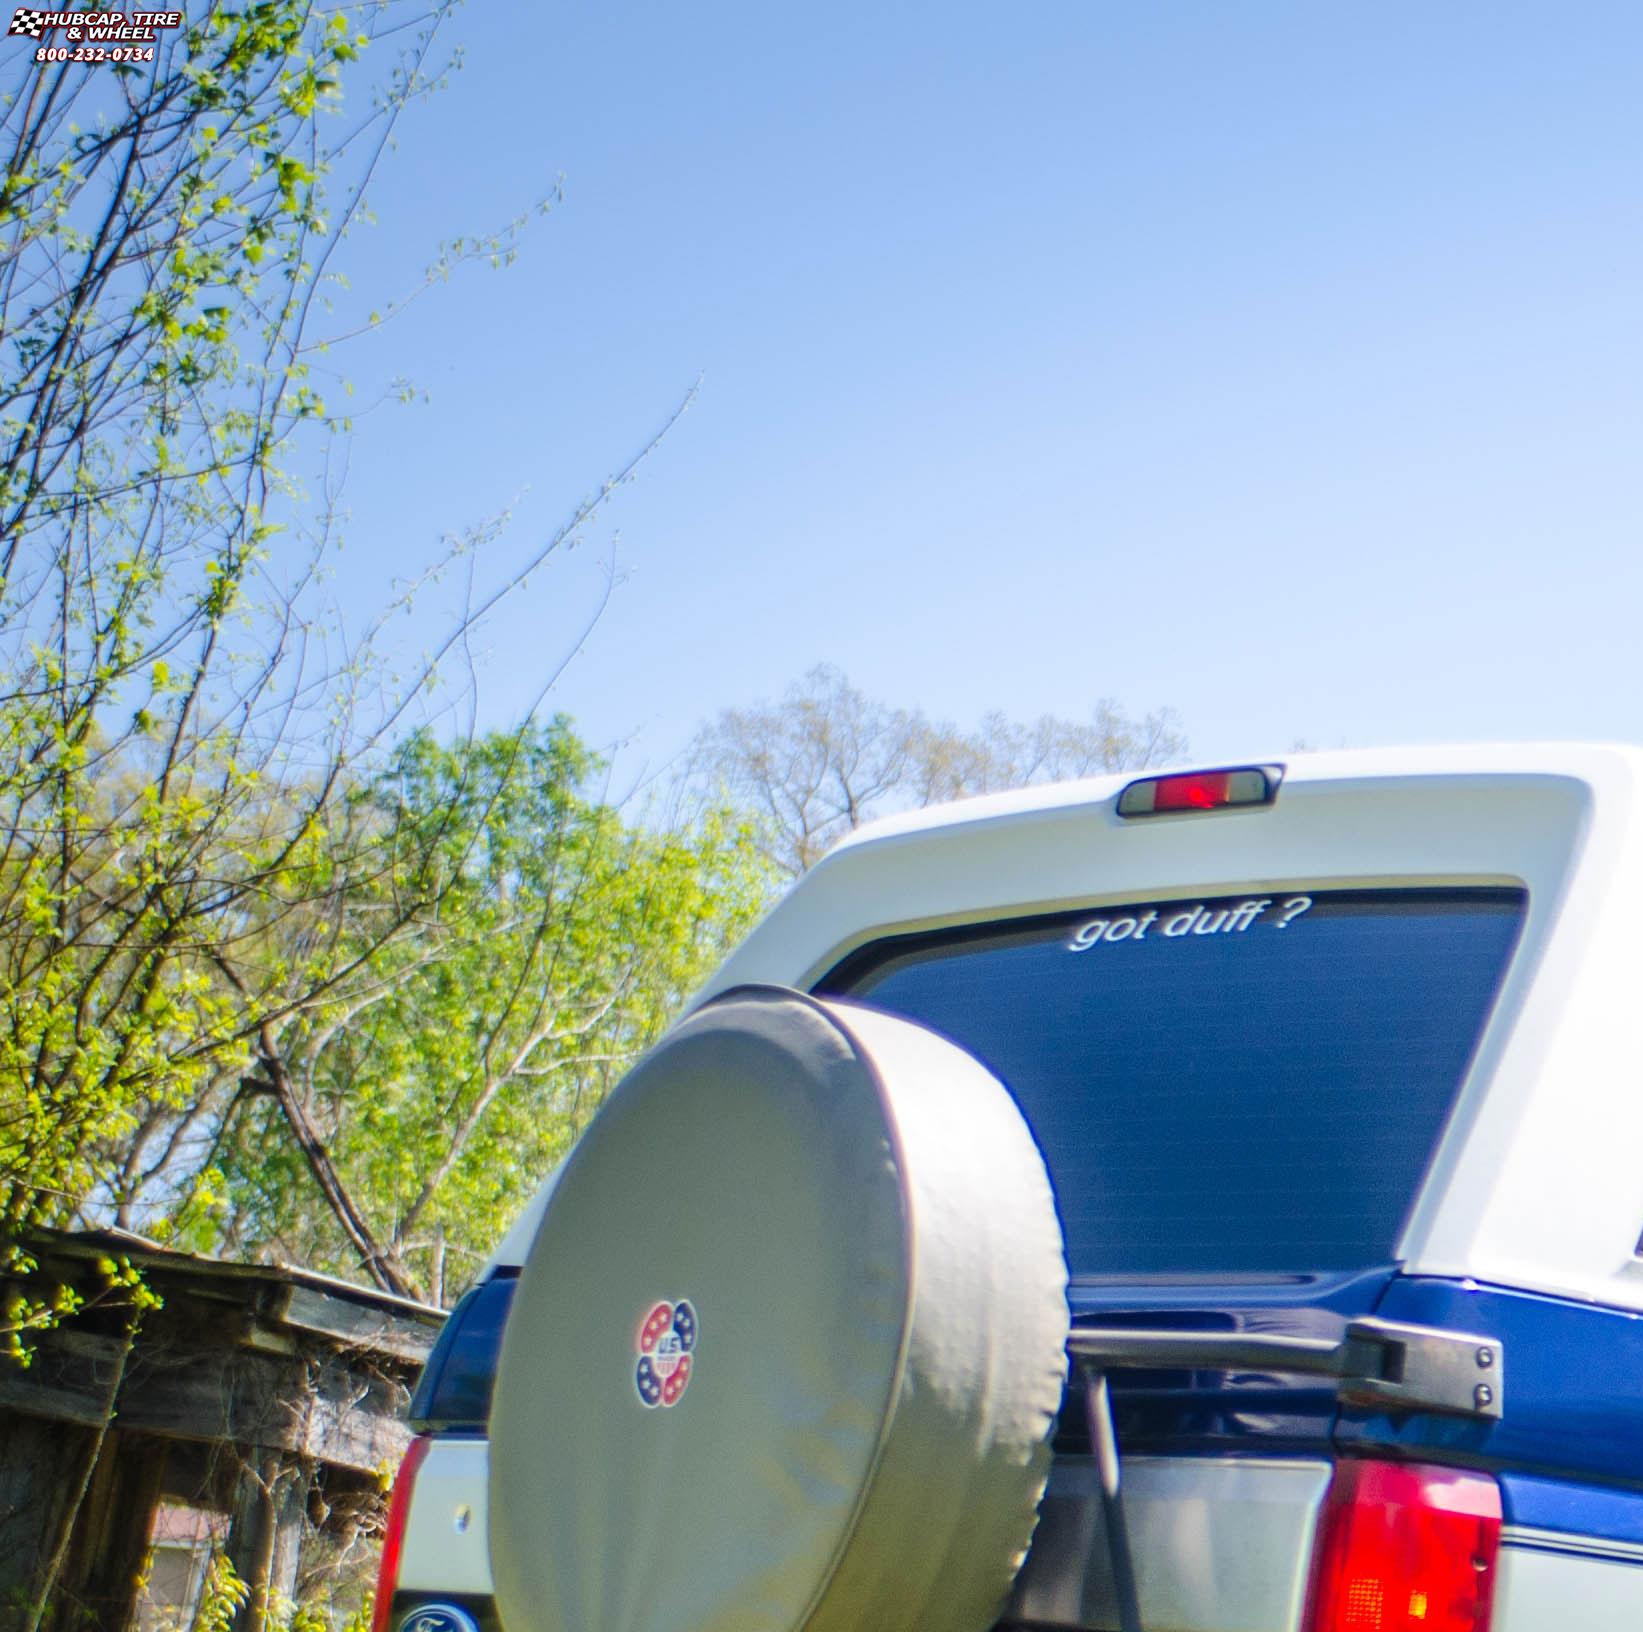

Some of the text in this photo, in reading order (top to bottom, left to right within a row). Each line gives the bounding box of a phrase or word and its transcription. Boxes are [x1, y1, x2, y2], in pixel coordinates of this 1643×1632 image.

[1068, 896, 1312, 951] got duff ?
